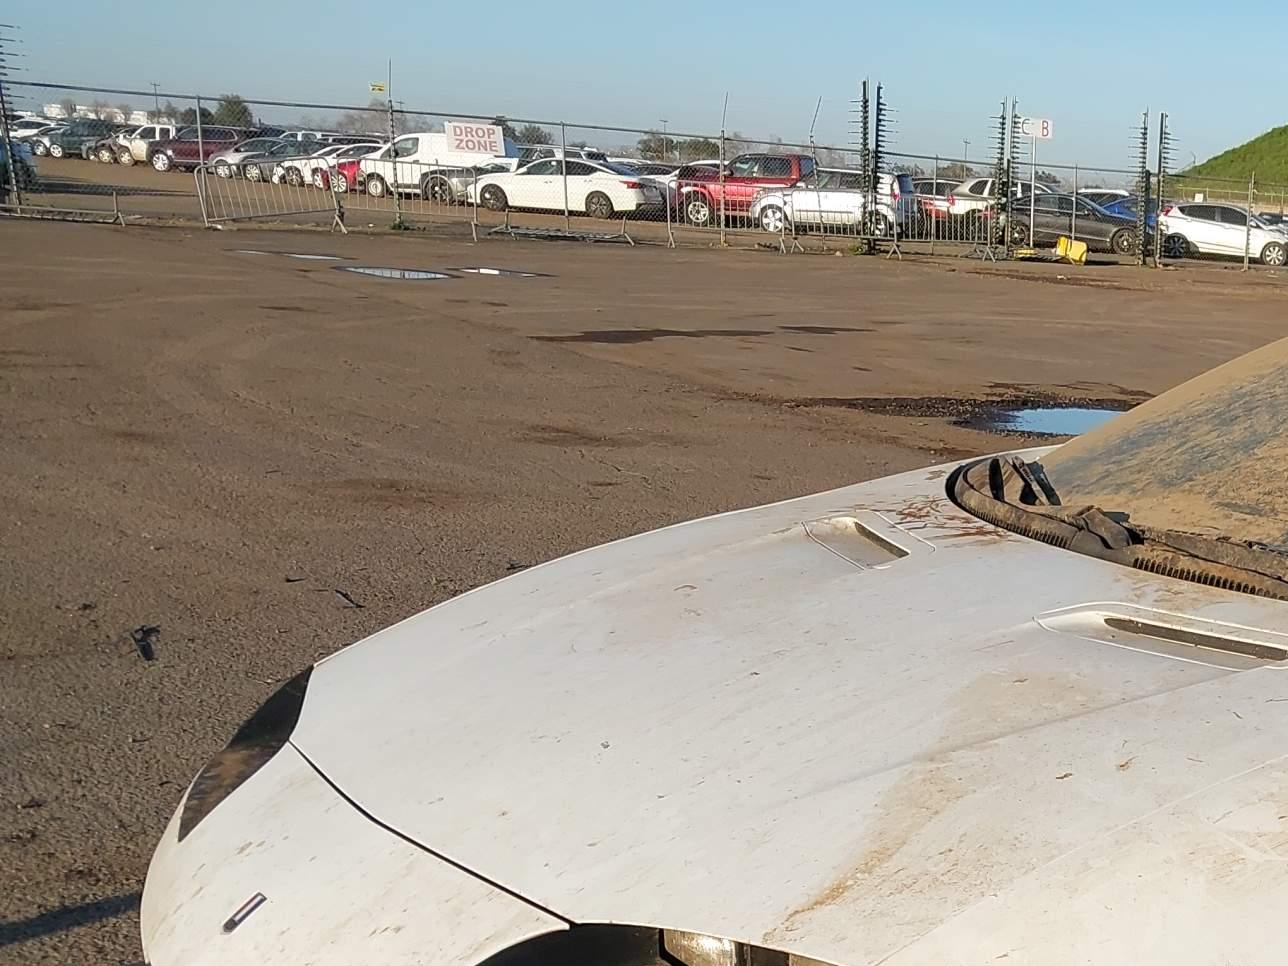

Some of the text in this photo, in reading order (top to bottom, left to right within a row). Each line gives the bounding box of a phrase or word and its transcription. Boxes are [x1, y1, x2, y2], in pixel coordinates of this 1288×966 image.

[452, 125, 496, 140] DROP
[1041, 119, 1050, 137] B
[454, 138, 499, 153] ZONE
